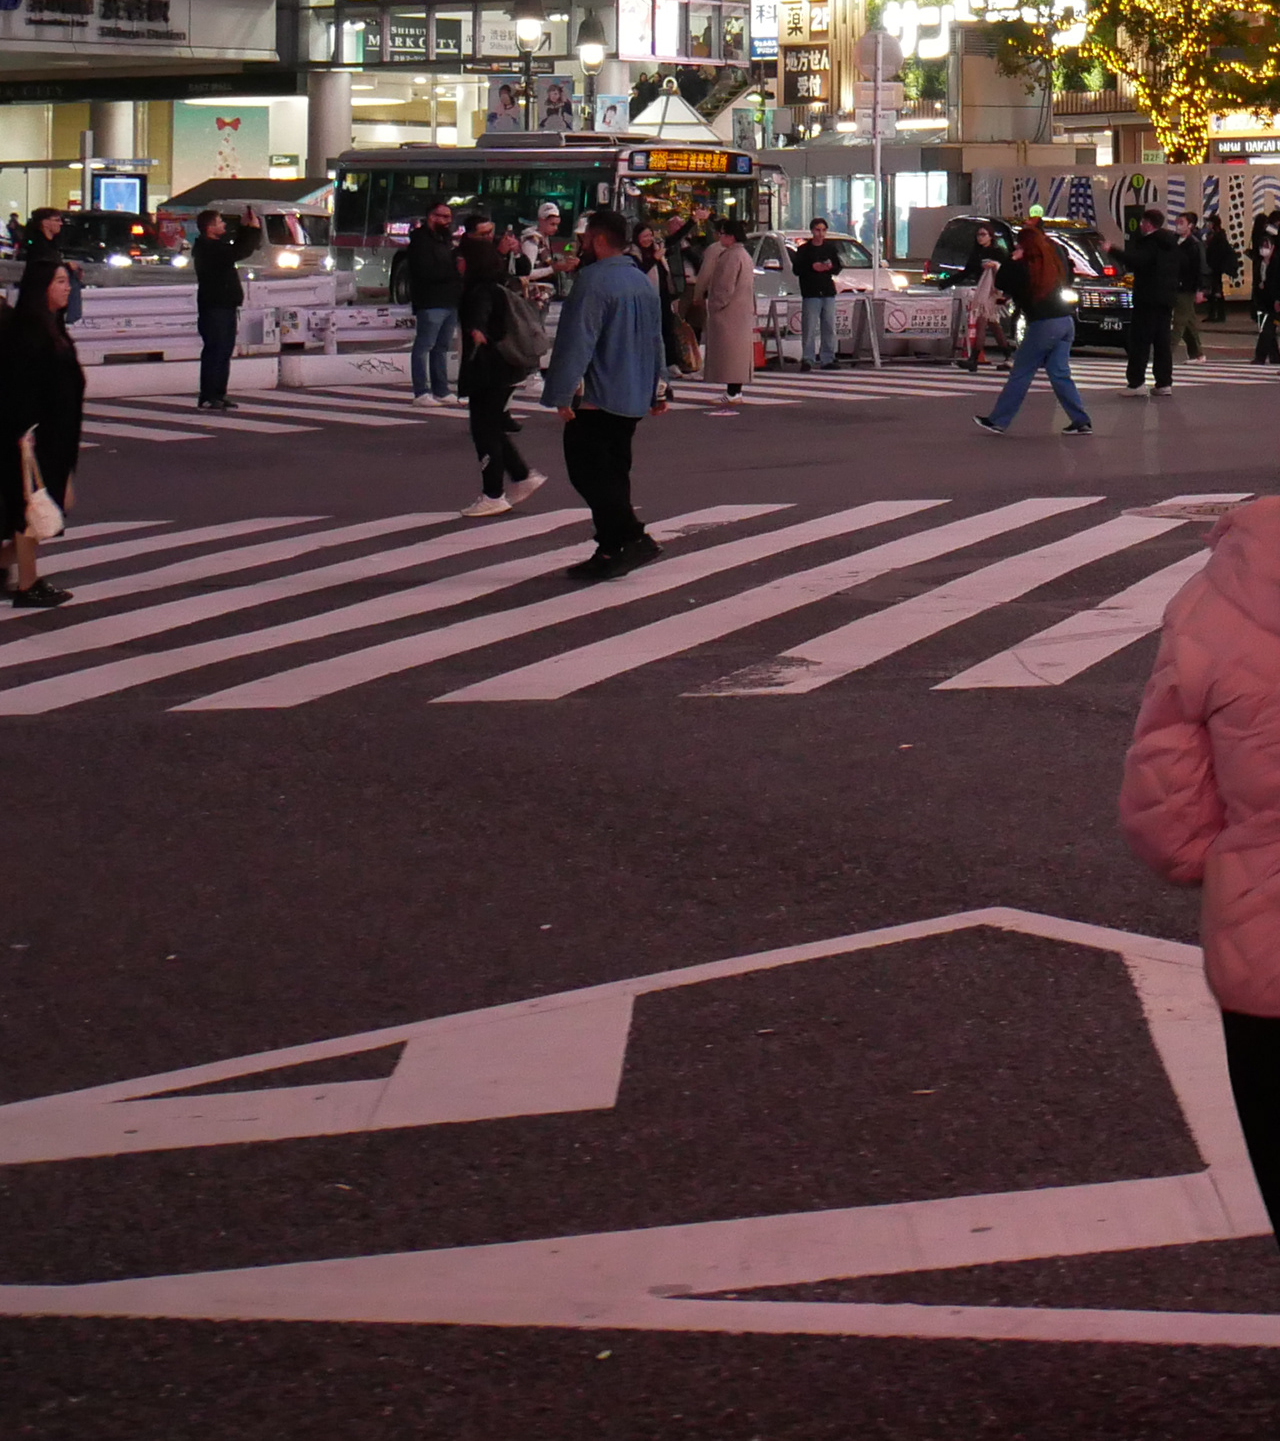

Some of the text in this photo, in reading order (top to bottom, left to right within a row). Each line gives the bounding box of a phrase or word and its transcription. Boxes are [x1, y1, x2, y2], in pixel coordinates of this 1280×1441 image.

[787, 3, 805, 38] 薬
[785, 48, 831, 73] 処方せん
[797, 74, 821, 98] 受付
